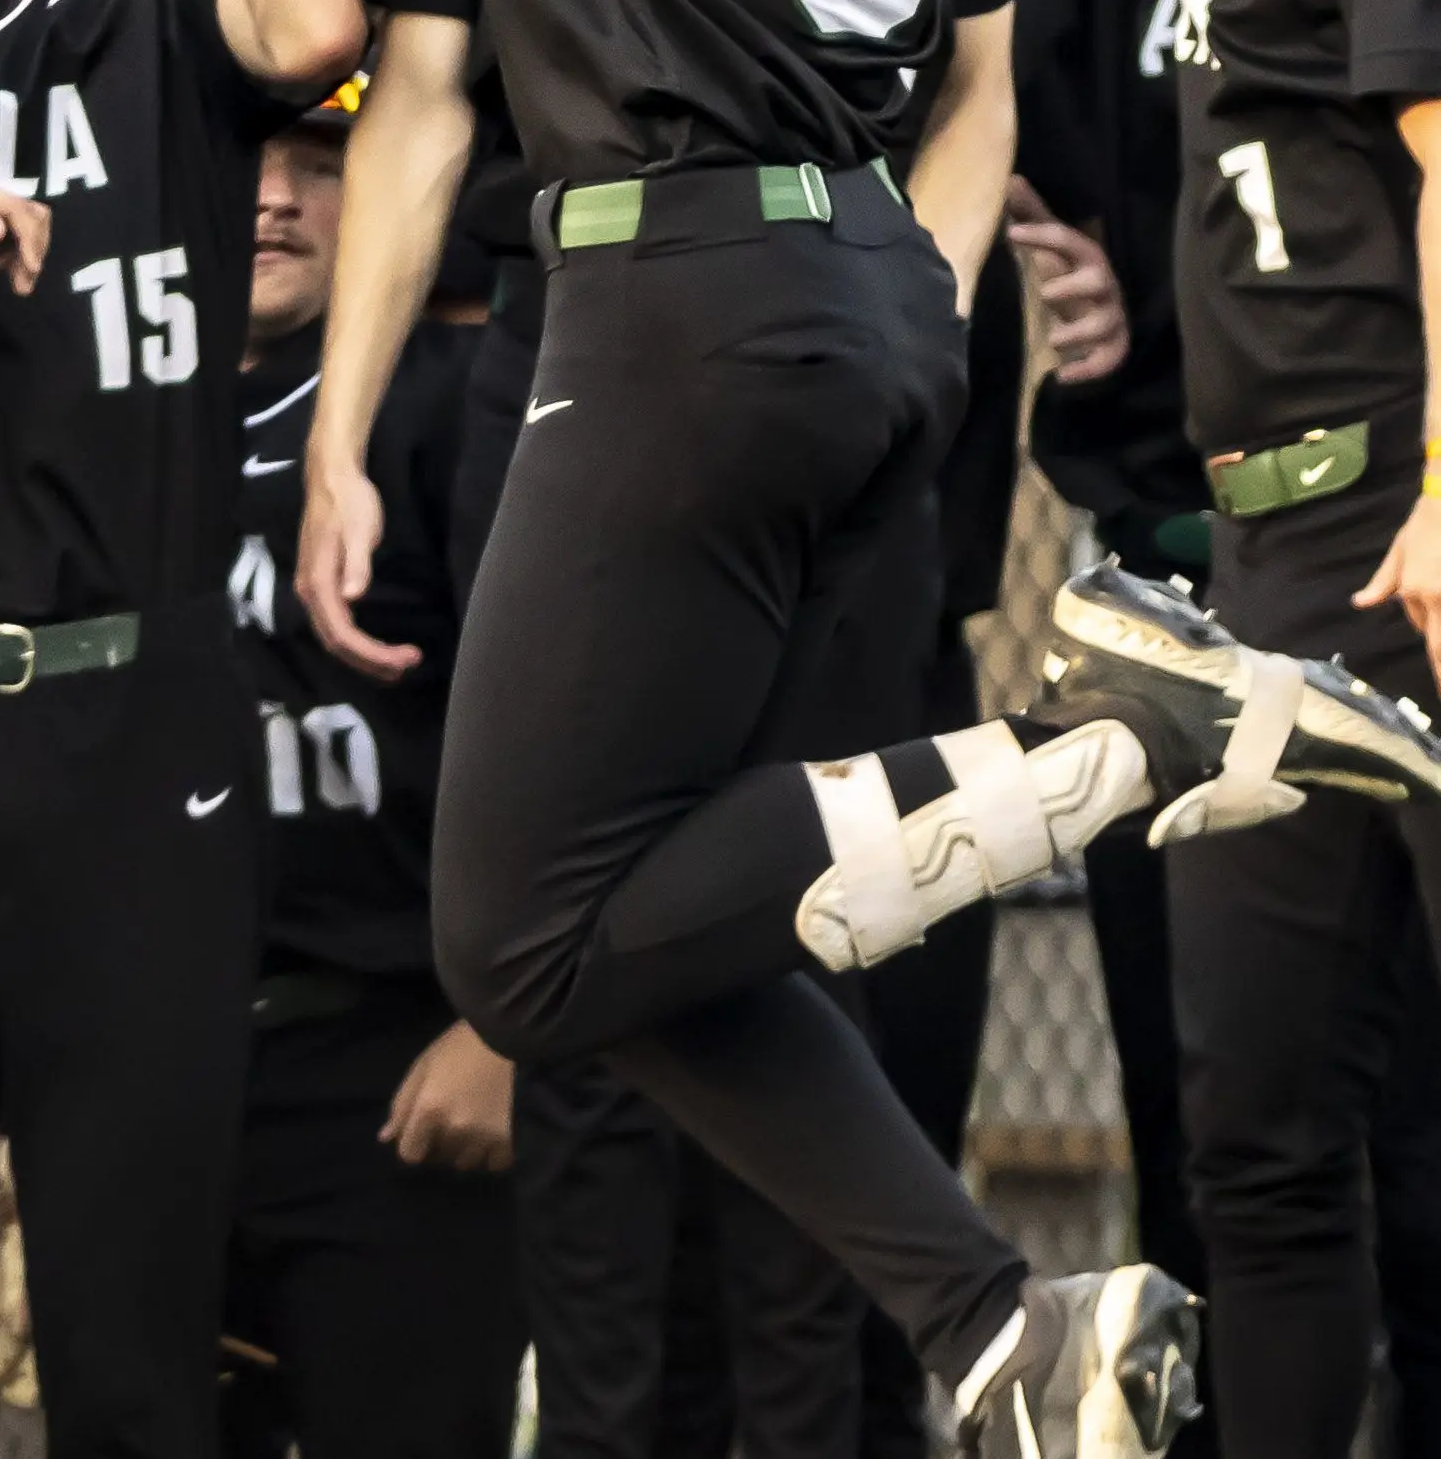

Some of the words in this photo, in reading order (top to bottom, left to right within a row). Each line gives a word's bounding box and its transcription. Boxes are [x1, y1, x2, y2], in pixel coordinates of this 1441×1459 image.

[1218, 141, 1290, 272] 1
[70, 246, 199, 391] 15
[259, 701, 381, 816] 10
